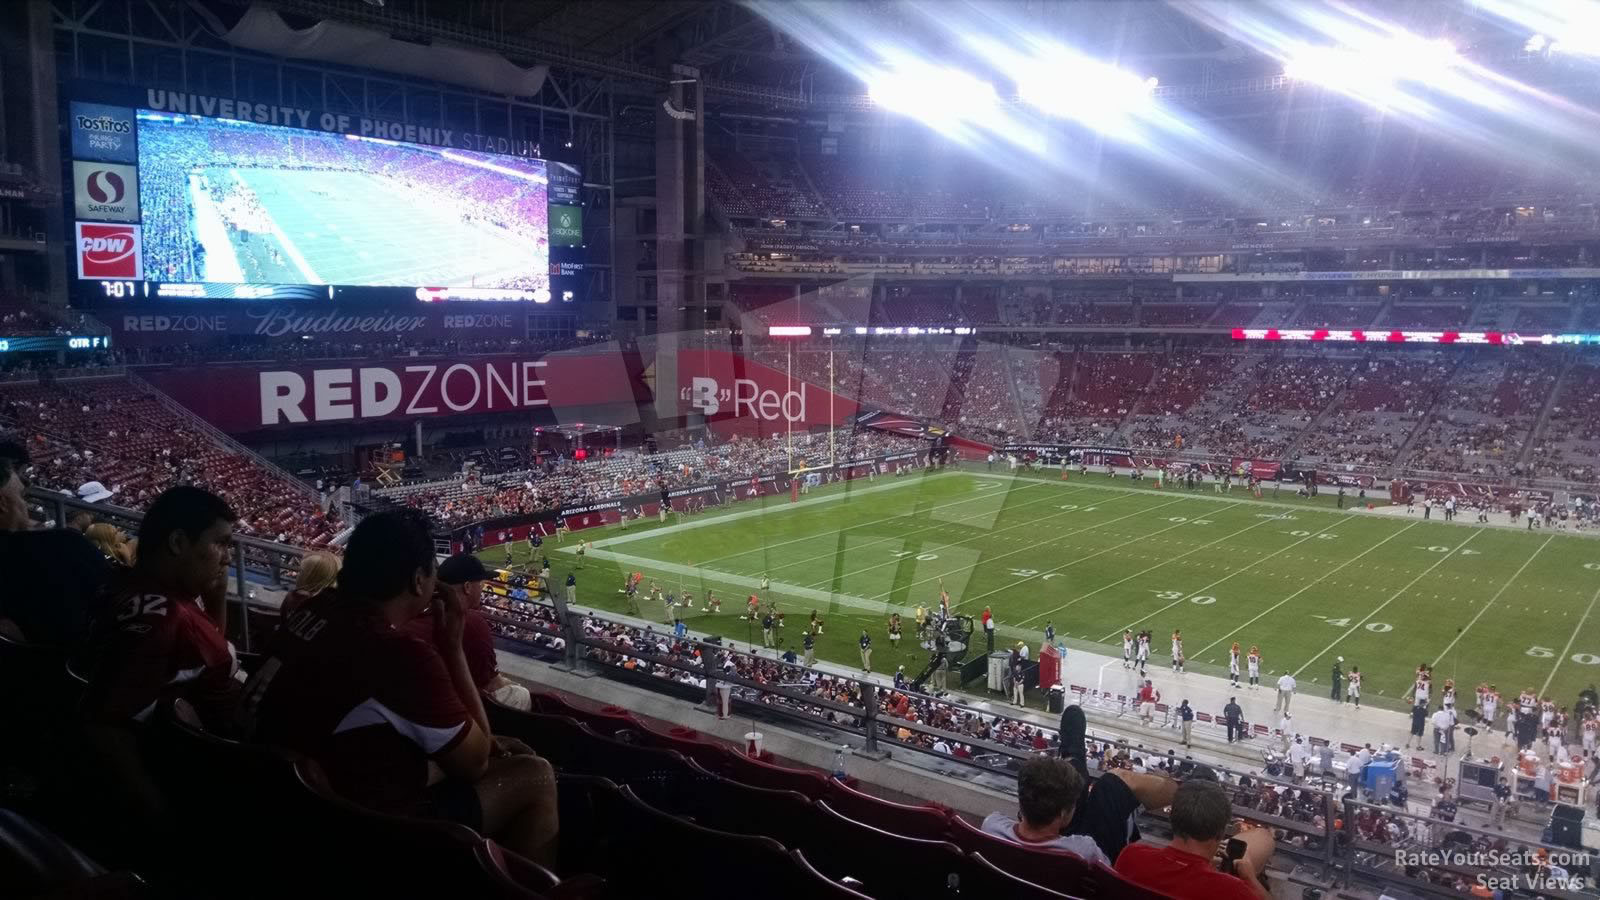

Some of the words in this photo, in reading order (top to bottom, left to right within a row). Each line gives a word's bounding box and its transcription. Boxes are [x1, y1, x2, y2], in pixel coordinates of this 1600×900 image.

[147, 88, 312, 128] UNIVERSITY
[320, 113, 350, 132] OF
[360, 118, 454, 147] PHOENIX
[462, 132, 542, 157] STADIUM
[89, 139, 121, 150] PARTY
[88, 204, 126, 213] SAFEWAY
[82, 237, 128, 253] CDW
[101, 281, 135, 298] 7:07
[123, 315, 228, 332] REDZONE
[246, 306, 425, 337] Budweiser
[443, 314, 513, 329] REDZONE
[69, 338, 90, 349] QTR
[259, 361, 549, 425] REDZONE
[734, 378, 806, 422] Red
[667, 489, 690, 498] ARIZONA
[690, 484, 717, 493] CARDINALS
[561, 506, 588, 516] ARIZONA
[588, 501, 621, 511] CARDINALS
[1325, 617, 1393, 633] 40
[1525, 645, 1600, 665] 50
